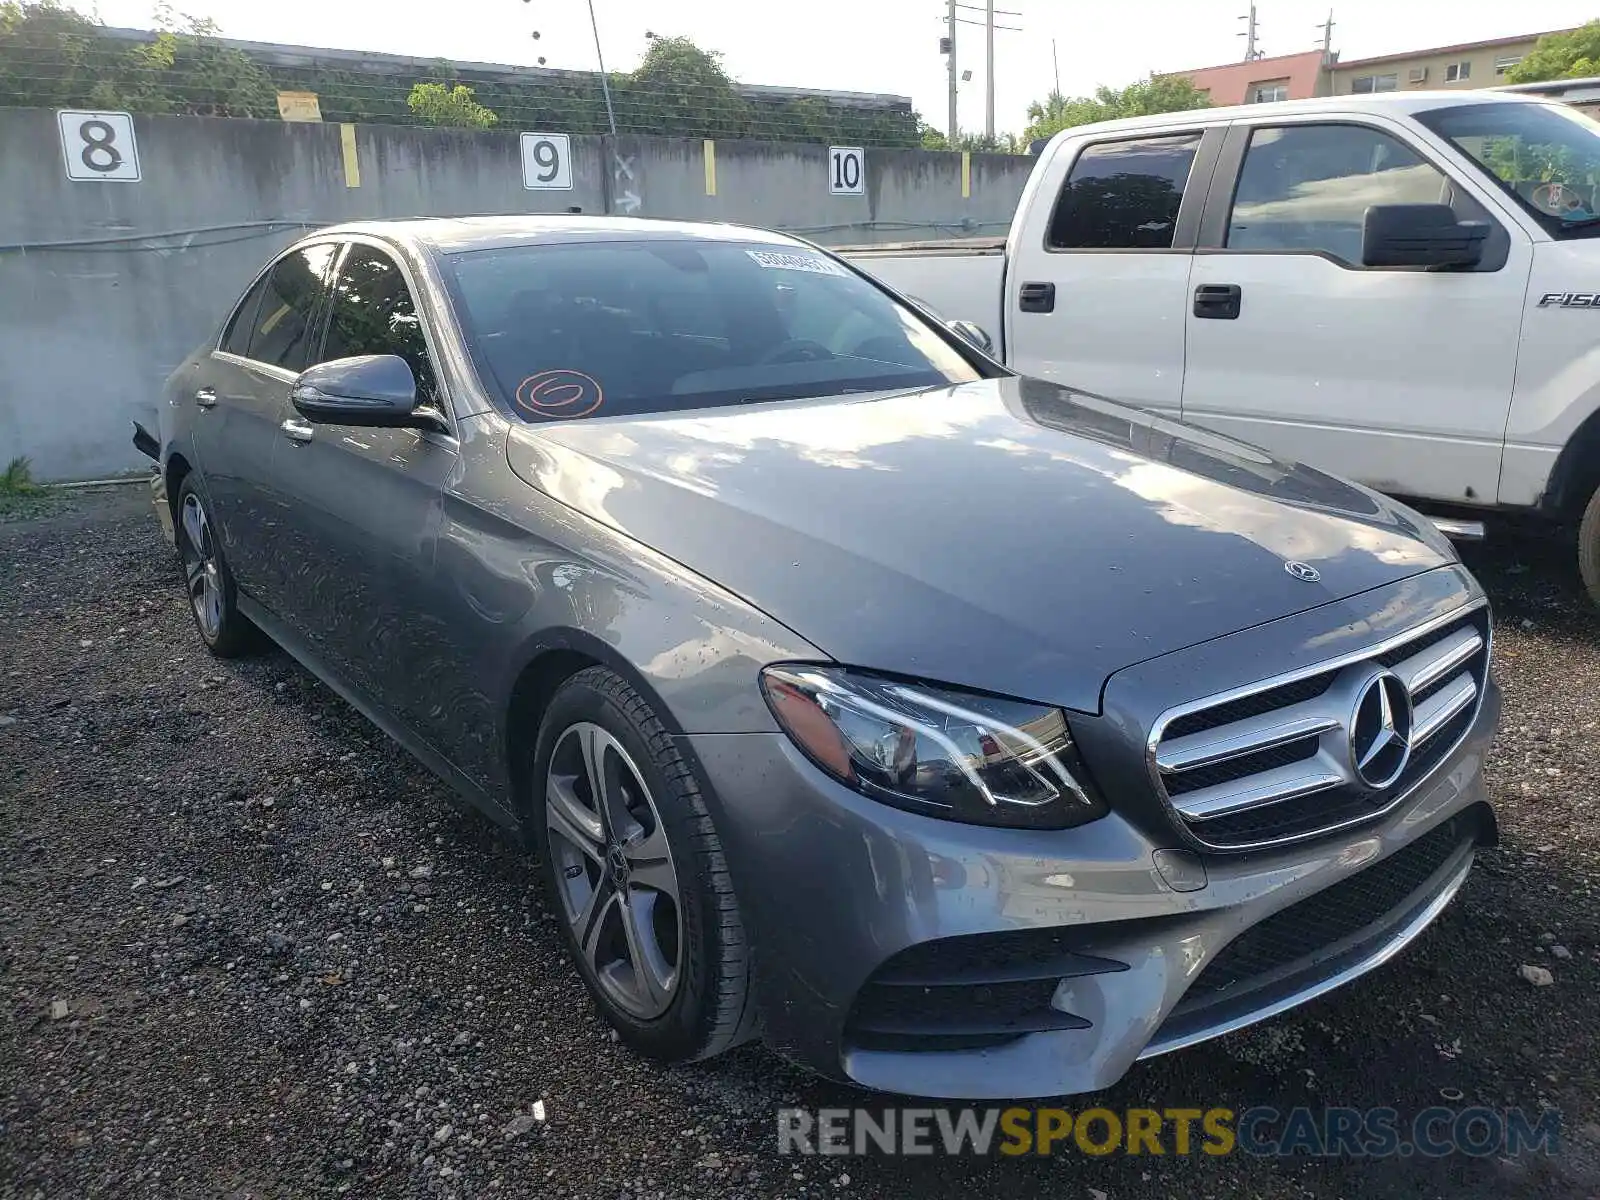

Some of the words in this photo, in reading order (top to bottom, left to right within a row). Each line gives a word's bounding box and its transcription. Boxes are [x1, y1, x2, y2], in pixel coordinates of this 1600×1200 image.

[80, 120, 122, 172] 8
[533, 140, 560, 182] 9
[833, 153, 859, 188] 10
